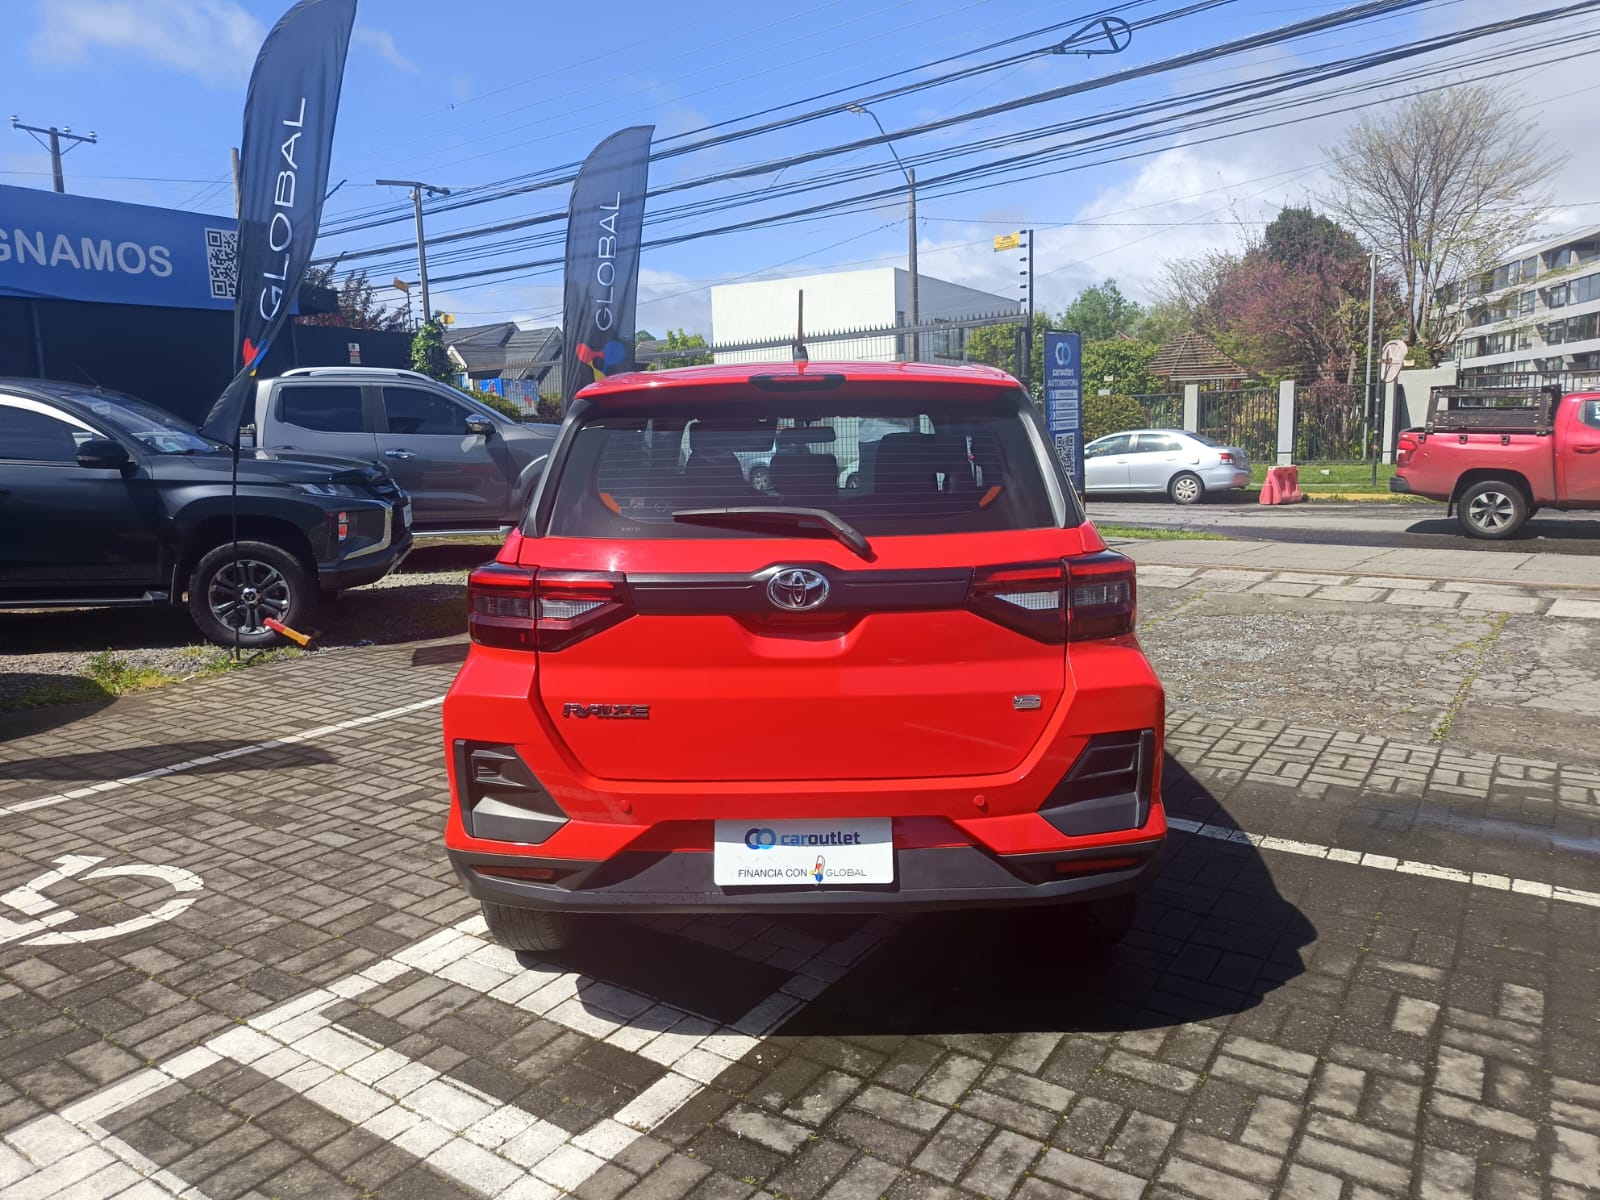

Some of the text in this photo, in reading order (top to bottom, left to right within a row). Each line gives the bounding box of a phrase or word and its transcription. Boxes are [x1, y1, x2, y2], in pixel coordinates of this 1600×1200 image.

[259, 97, 306, 322] GLOBAL
[595, 191, 621, 332] GLOBAL
[738, 867, 868, 879] FINANCIA CON GLOBAL
[780, 831, 861, 846] caroutlet
